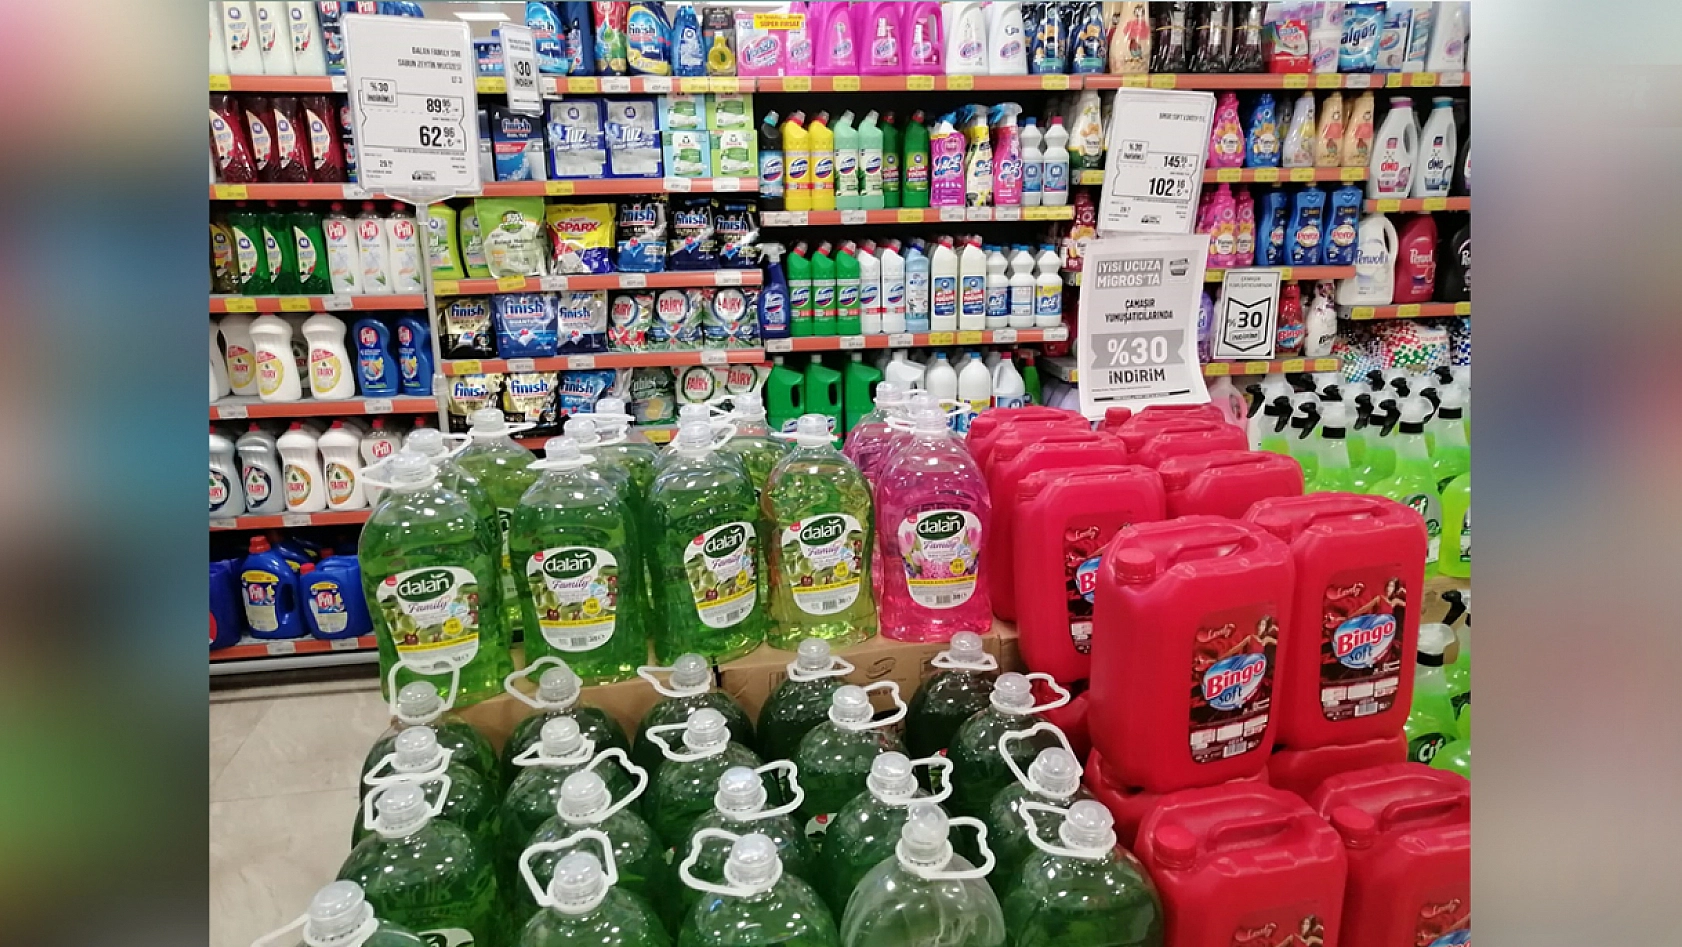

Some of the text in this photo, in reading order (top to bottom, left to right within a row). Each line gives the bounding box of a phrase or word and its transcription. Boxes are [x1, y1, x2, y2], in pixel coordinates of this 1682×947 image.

[564, 126, 587, 143] TUZ
[621, 126, 642, 142] TUZ
[396, 223, 411, 237] Pril
[555, 220, 597, 233] SPARX
[1124, 260, 1161, 273] UCUZA
[451, 302, 485, 317] finish
[505, 296, 544, 313] finish
[559, 304, 590, 318] finish
[659, 298, 684, 312] FAIRY
[1107, 336, 1168, 366] %30
[510, 380, 549, 395] finish
[545, 555, 592, 573] dalan
[399, 576, 450, 597] dalan
[552, 577, 588, 591] Family
[408, 600, 447, 615] Family
[1337, 622, 1396, 658] Bingo
[1206, 660, 1265, 701] Bingo
